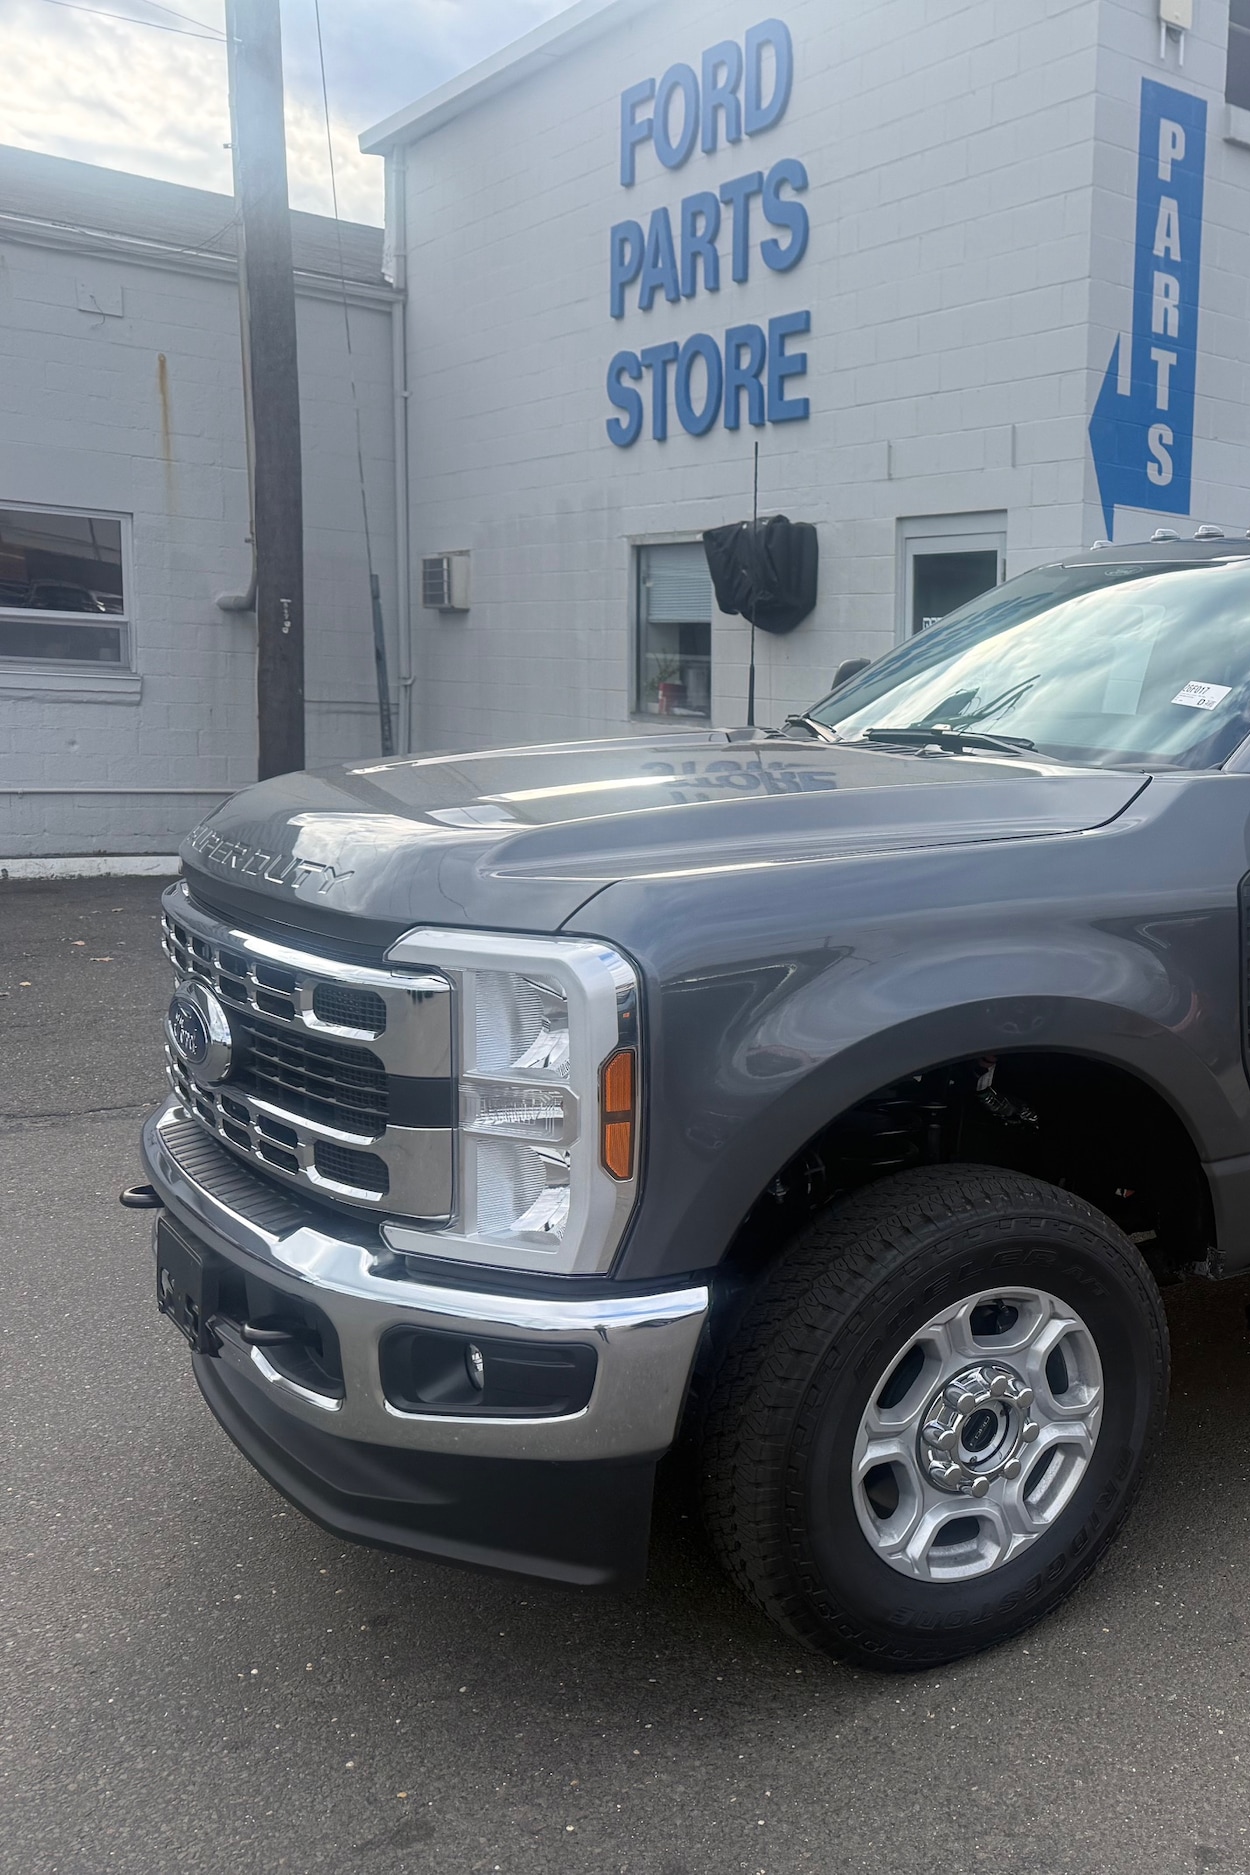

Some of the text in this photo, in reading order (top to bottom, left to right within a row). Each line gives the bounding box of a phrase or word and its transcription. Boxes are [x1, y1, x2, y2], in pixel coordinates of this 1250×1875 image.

[620, 18, 793, 188] FORD
[610, 158, 809, 319] PARTS
[1146, 117, 1186, 487] PARTS
[606, 310, 811, 448] STORE
[242, 849, 355, 895] DUTY
